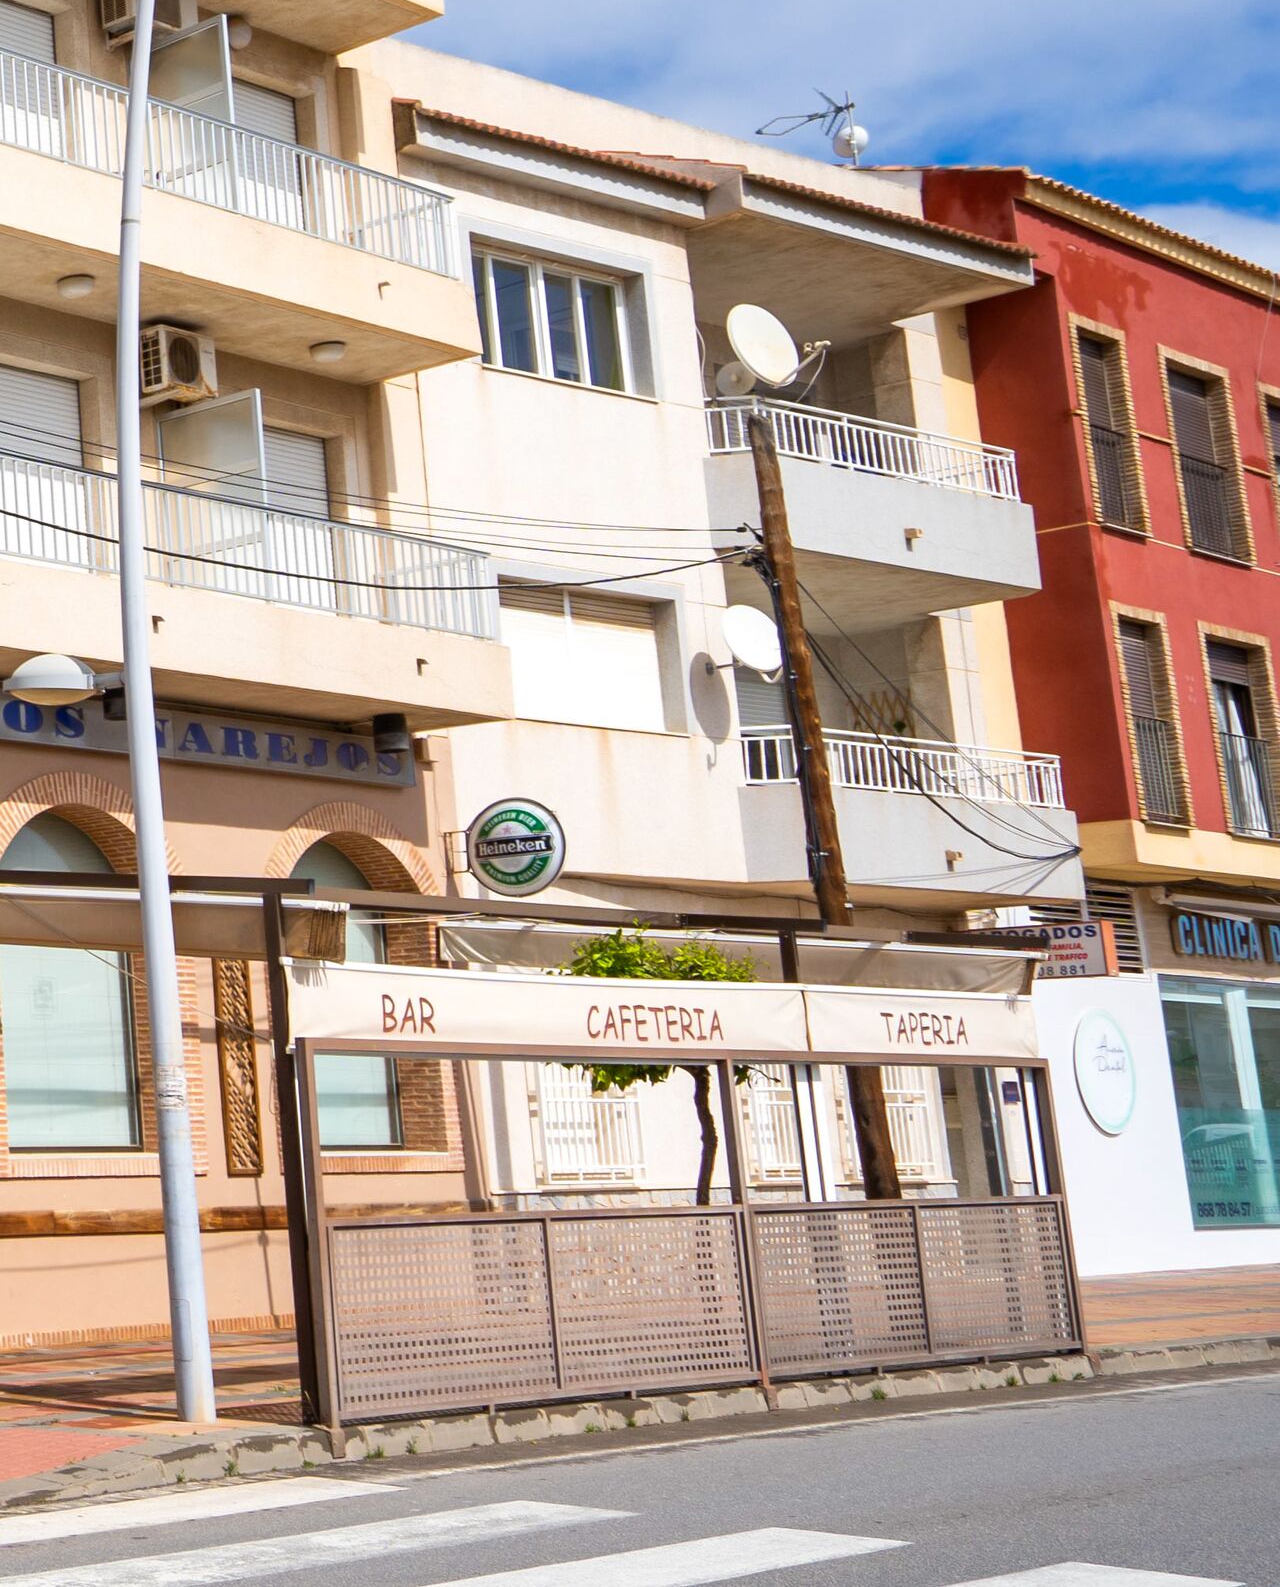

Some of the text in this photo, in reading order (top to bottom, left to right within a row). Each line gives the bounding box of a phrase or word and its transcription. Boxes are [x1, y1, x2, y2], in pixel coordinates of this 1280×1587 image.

[478, 838, 547, 856] Heineken
[1060, 965, 1086, 976] 881
[381, 994, 969, 1046] BAR CAFETERIA TAPERIA
